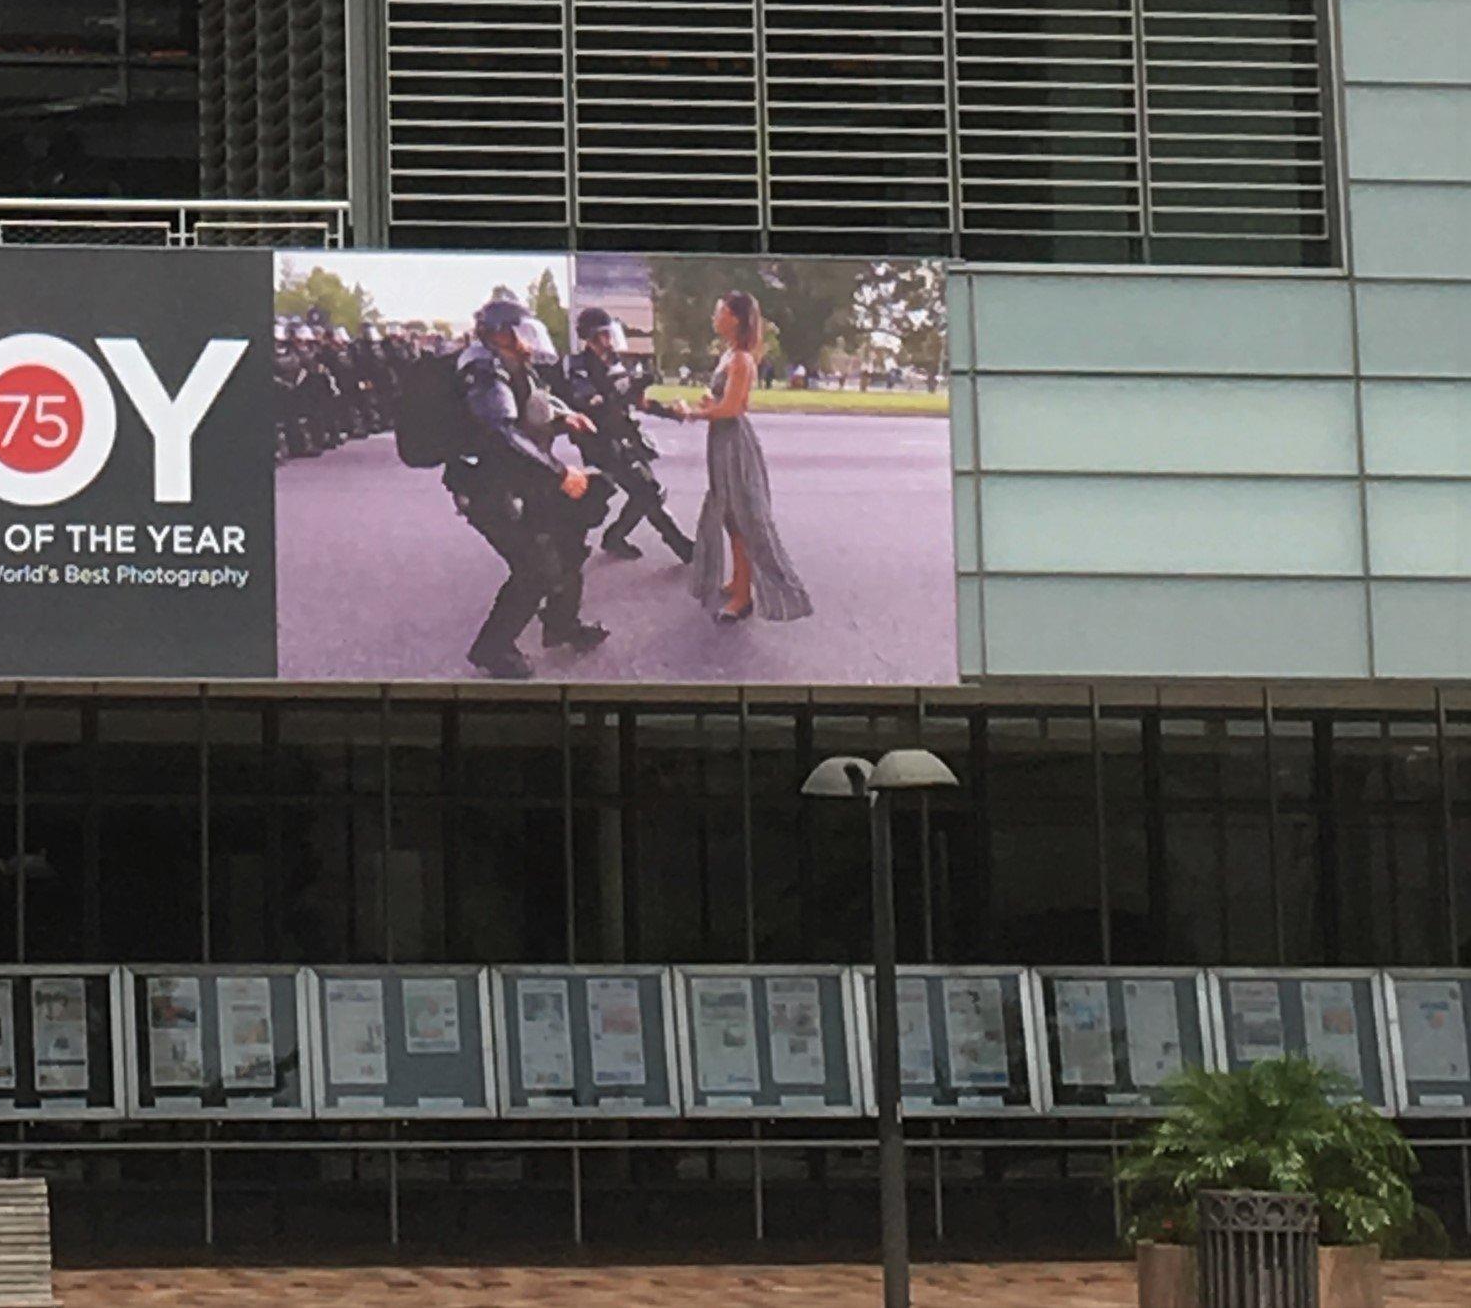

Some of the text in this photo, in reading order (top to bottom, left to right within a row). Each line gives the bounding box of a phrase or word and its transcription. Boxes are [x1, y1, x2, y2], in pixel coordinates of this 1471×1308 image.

[4, 523, 55, 553] OF
[65, 524, 136, 553] THE
[147, 525, 246, 554] YEAR
[64, 564, 110, 584] Best
[117, 565, 249, 588] Photography
